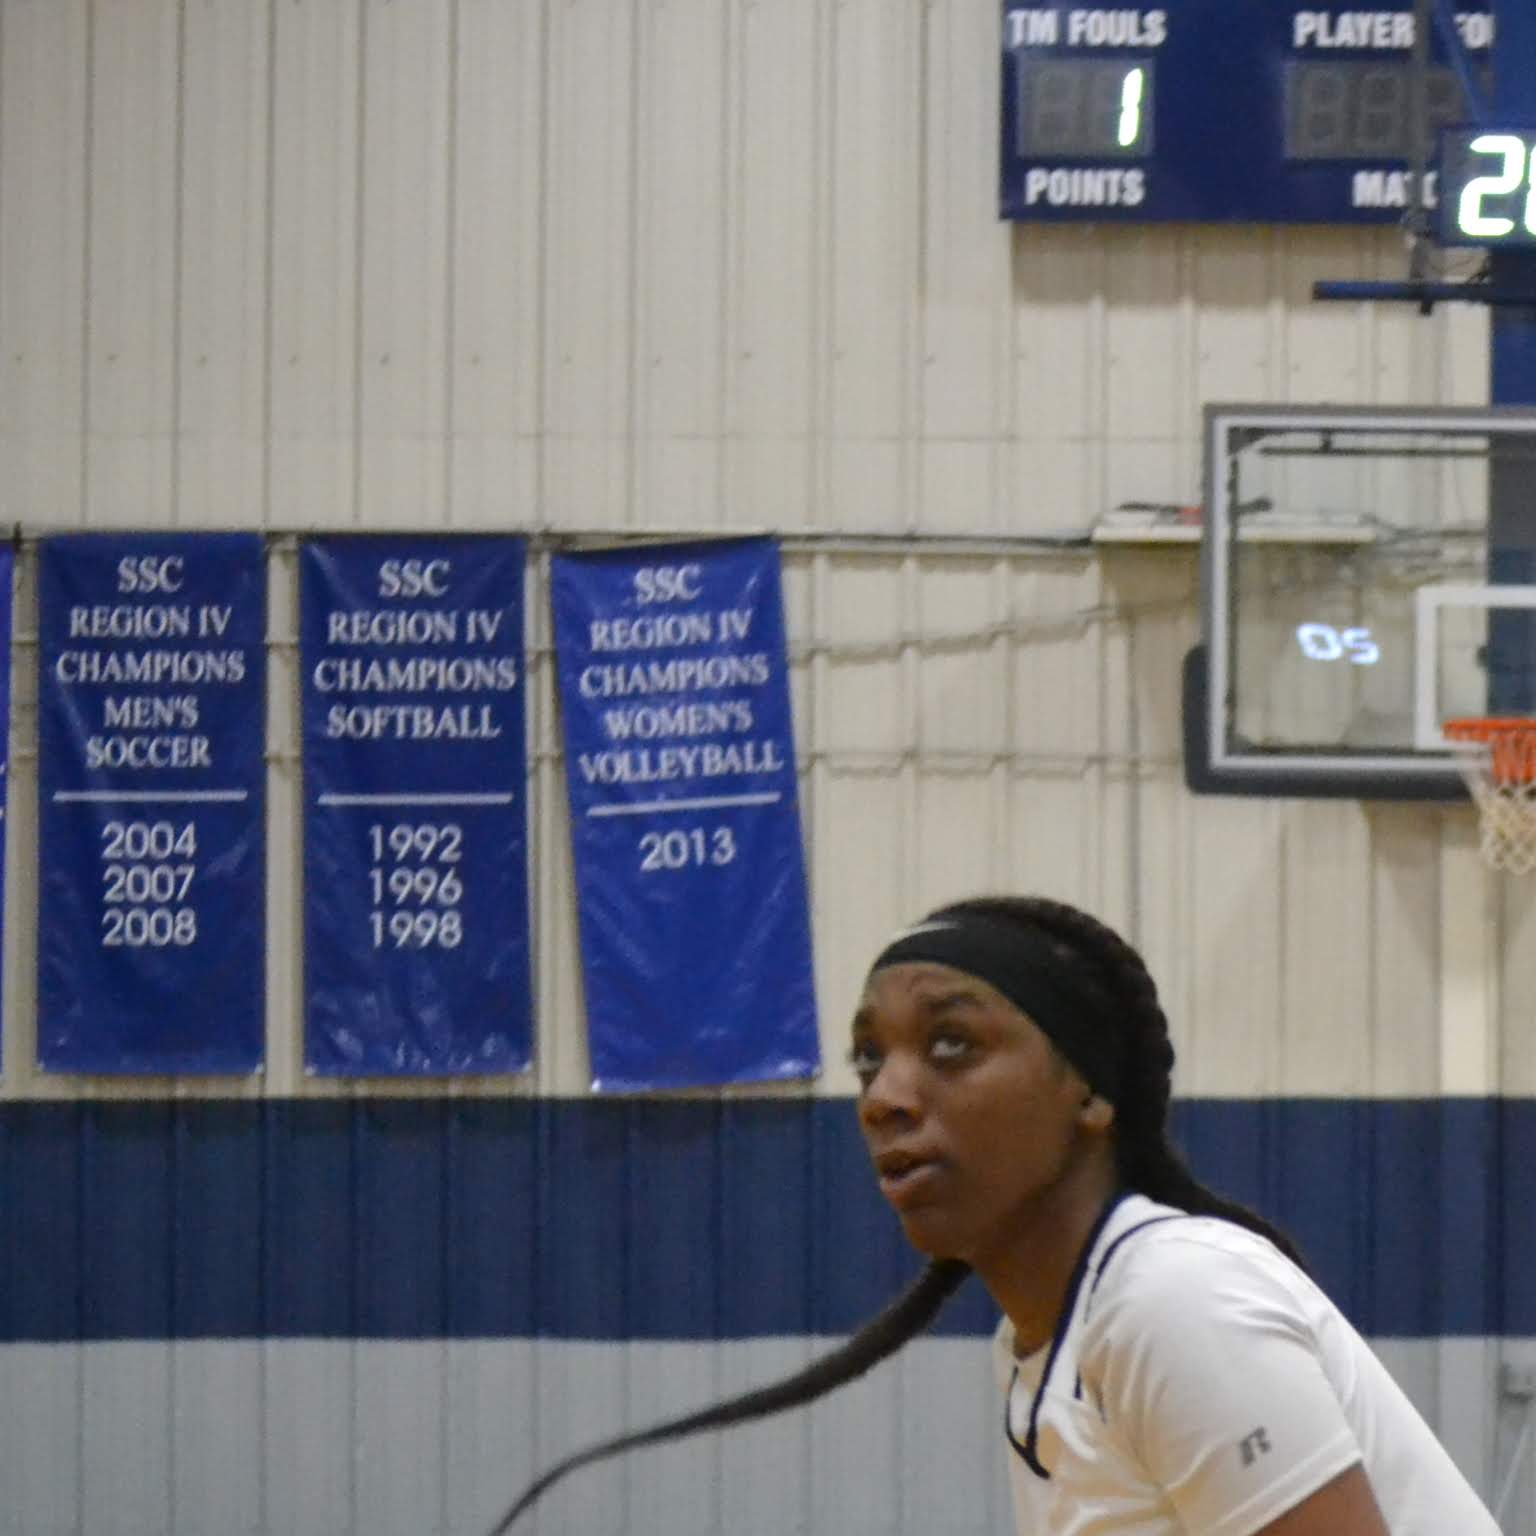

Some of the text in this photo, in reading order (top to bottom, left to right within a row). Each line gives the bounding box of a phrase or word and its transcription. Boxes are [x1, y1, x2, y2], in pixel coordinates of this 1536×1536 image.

[1008, 9, 1168, 48] TM FOULS
[1294, 11, 1416, 48] PLAYER
[1118, 67, 1143, 147] 1
[1024, 167, 1145, 206] POINTS
[117, 556, 184, 593] SSC
[379, 560, 450, 597] SSC
[633, 565, 703, 604] SSC
[69, 606, 232, 639] REGION IV
[328, 611, 504, 646] REGION IV
[590, 609, 754, 652] REGION IV
[55, 650, 246, 684] CHAMPIONS
[313, 657, 518, 693] CHAMPIONS
[579, 655, 771, 700] CHAMPIONS
[104, 696, 199, 729] MEN'S
[327, 705, 501, 741] SOFTBALL
[604, 700, 754, 742] WOMEN'S
[86, 737, 212, 769] SOCCER
[579, 740, 783, 784] VOLLEYBALL
[101, 822, 198, 861] 2004
[369, 825, 463, 863] 1992
[639, 828, 738, 872] 2013
[101, 866, 195, 904] 2007
[369, 868, 463, 907] 1996
[101, 910, 198, 947] 2008
[369, 911, 463, 950] 1998
